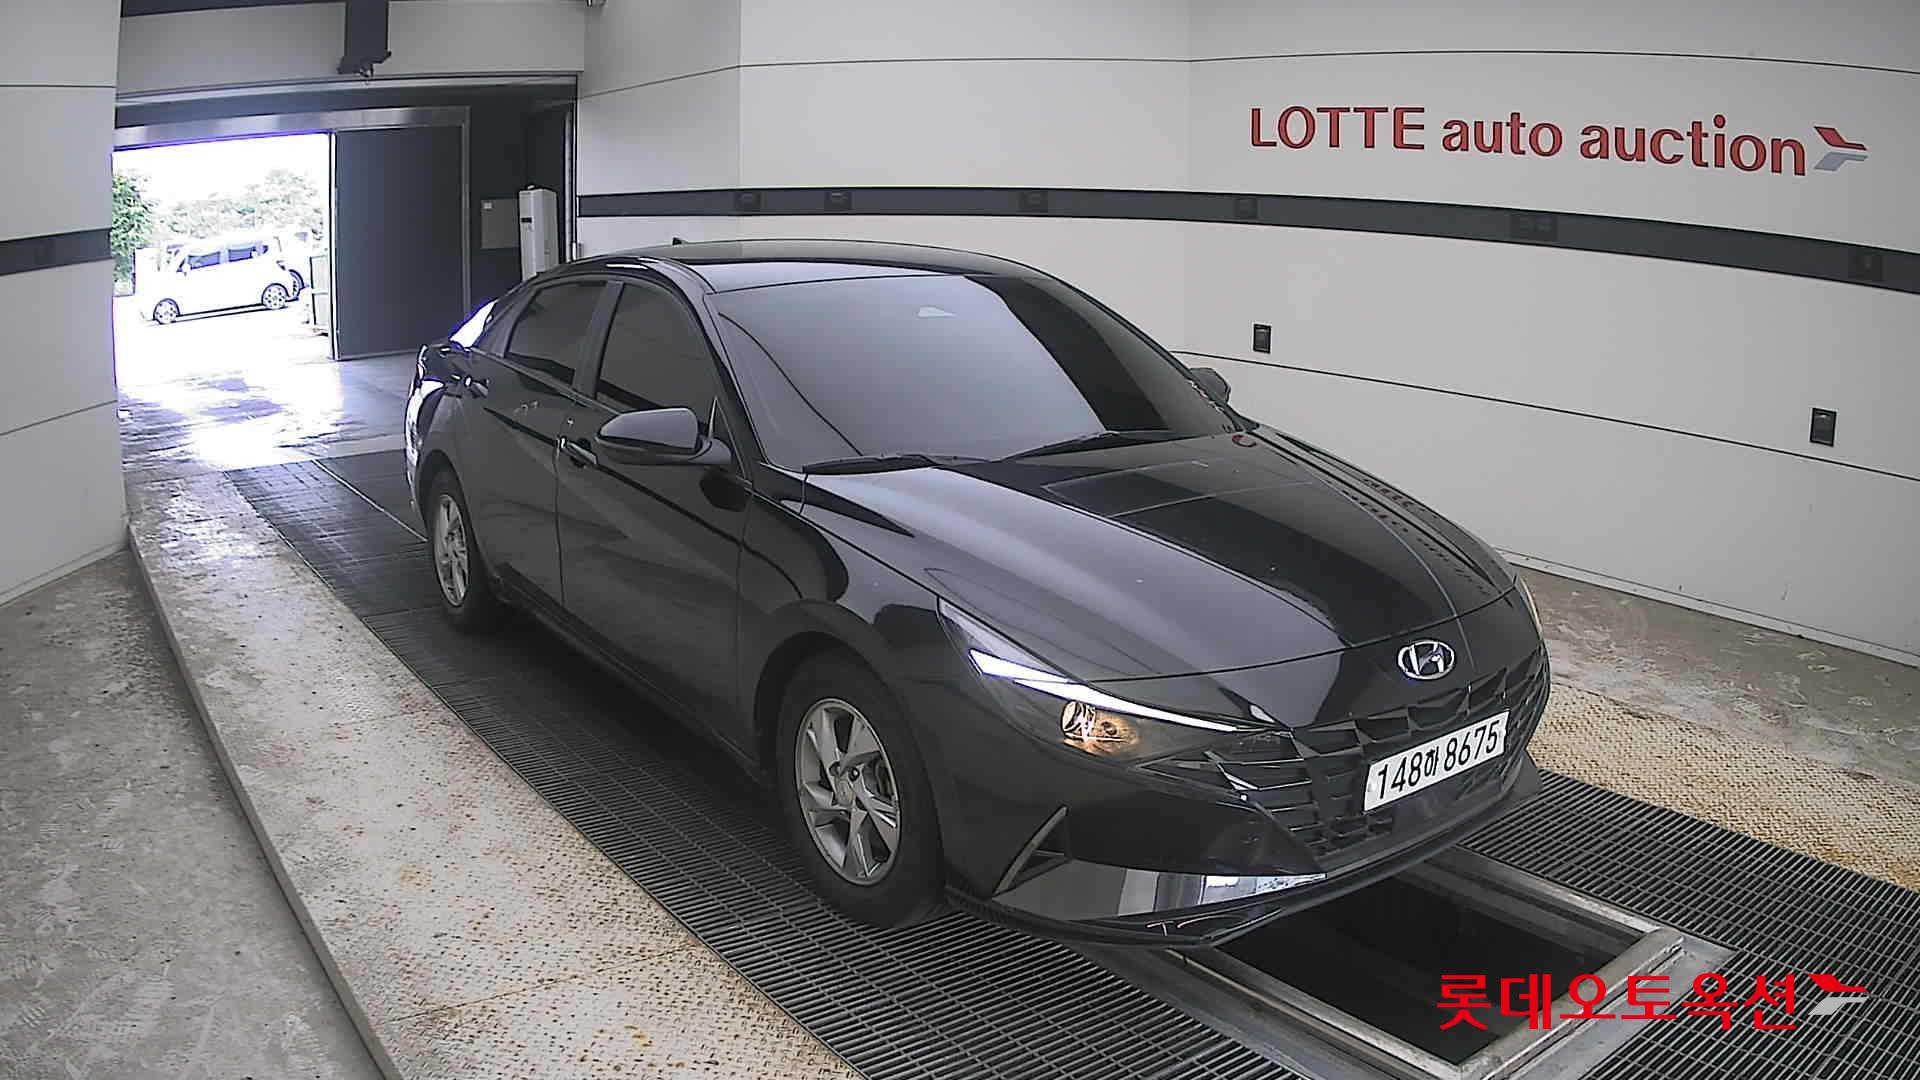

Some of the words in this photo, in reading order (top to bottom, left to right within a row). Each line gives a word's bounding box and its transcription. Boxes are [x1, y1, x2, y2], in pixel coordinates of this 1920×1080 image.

[1250, 104, 1426, 151] LOTTE
[1442, 112, 1564, 158] auto
[1579, 114, 1808, 177] auction
[1443, 719, 1500, 772] 8675
